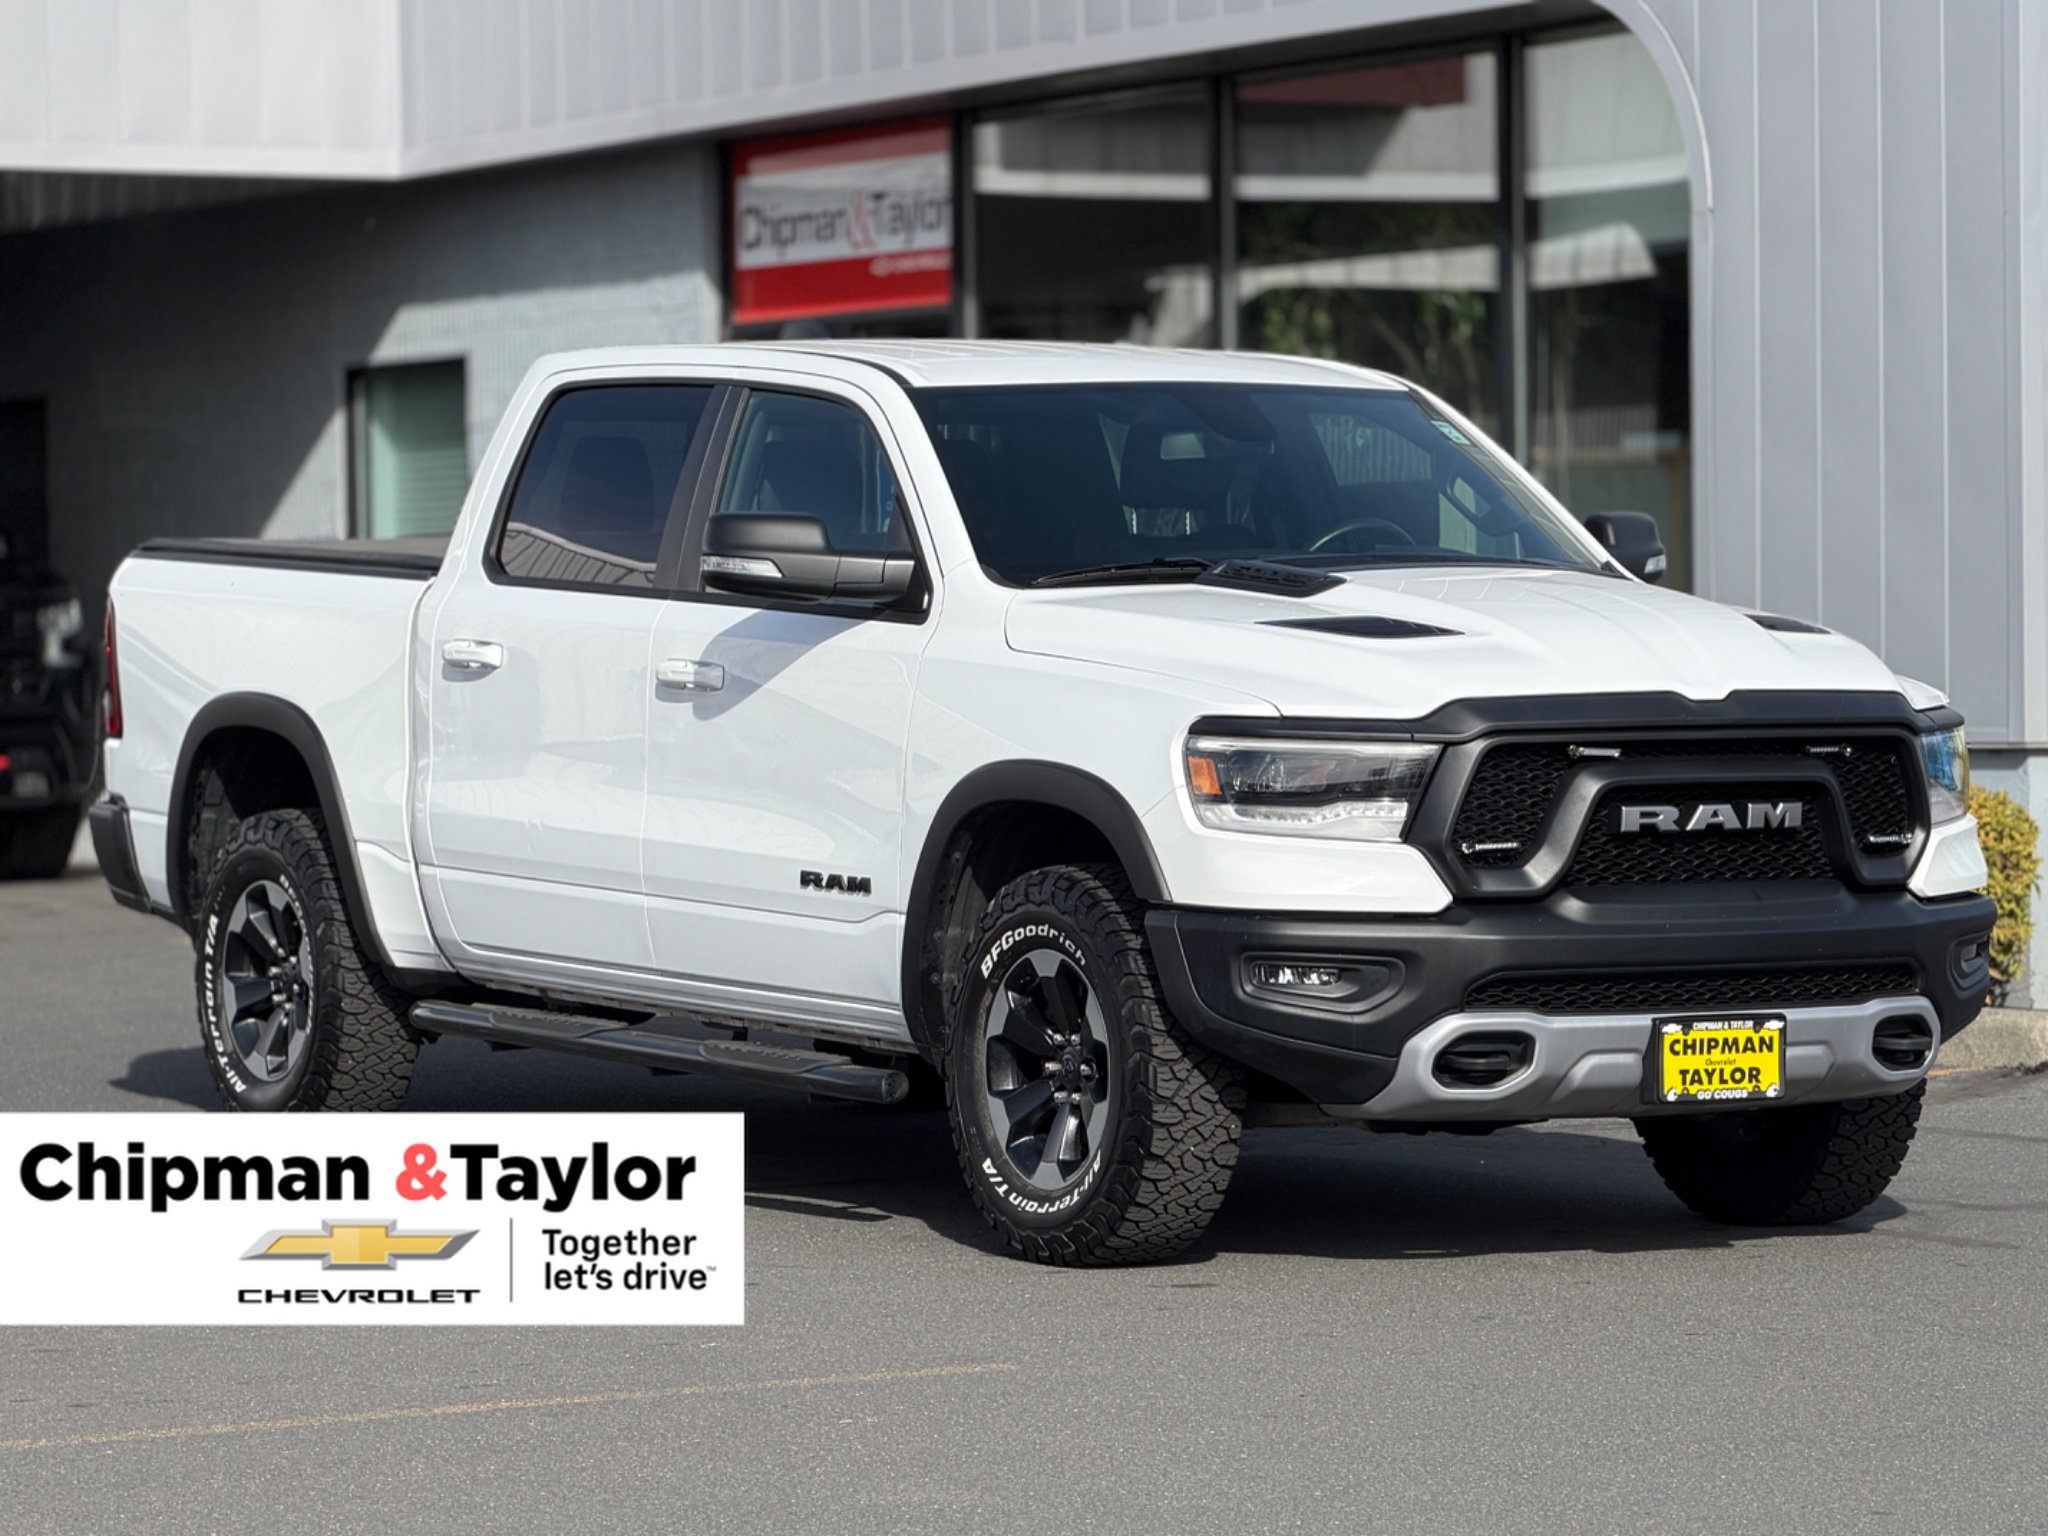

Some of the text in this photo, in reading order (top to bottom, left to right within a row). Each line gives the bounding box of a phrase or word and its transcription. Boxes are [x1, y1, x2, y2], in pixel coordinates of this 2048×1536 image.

[1620, 802, 1803, 833] RAM
[800, 869, 872, 896] RAM
[980, 923, 1086, 979] BFGoodrich
[1692, 1021, 1723, 1031] CHIPMAN
[1669, 1035, 1774, 1056] CHIPMAN
[1705, 1058, 1736, 1067] Chevrolet
[1679, 1066, 1761, 1086] TAYLOR
[1697, 1088, 1748, 1100] GO COUGS
